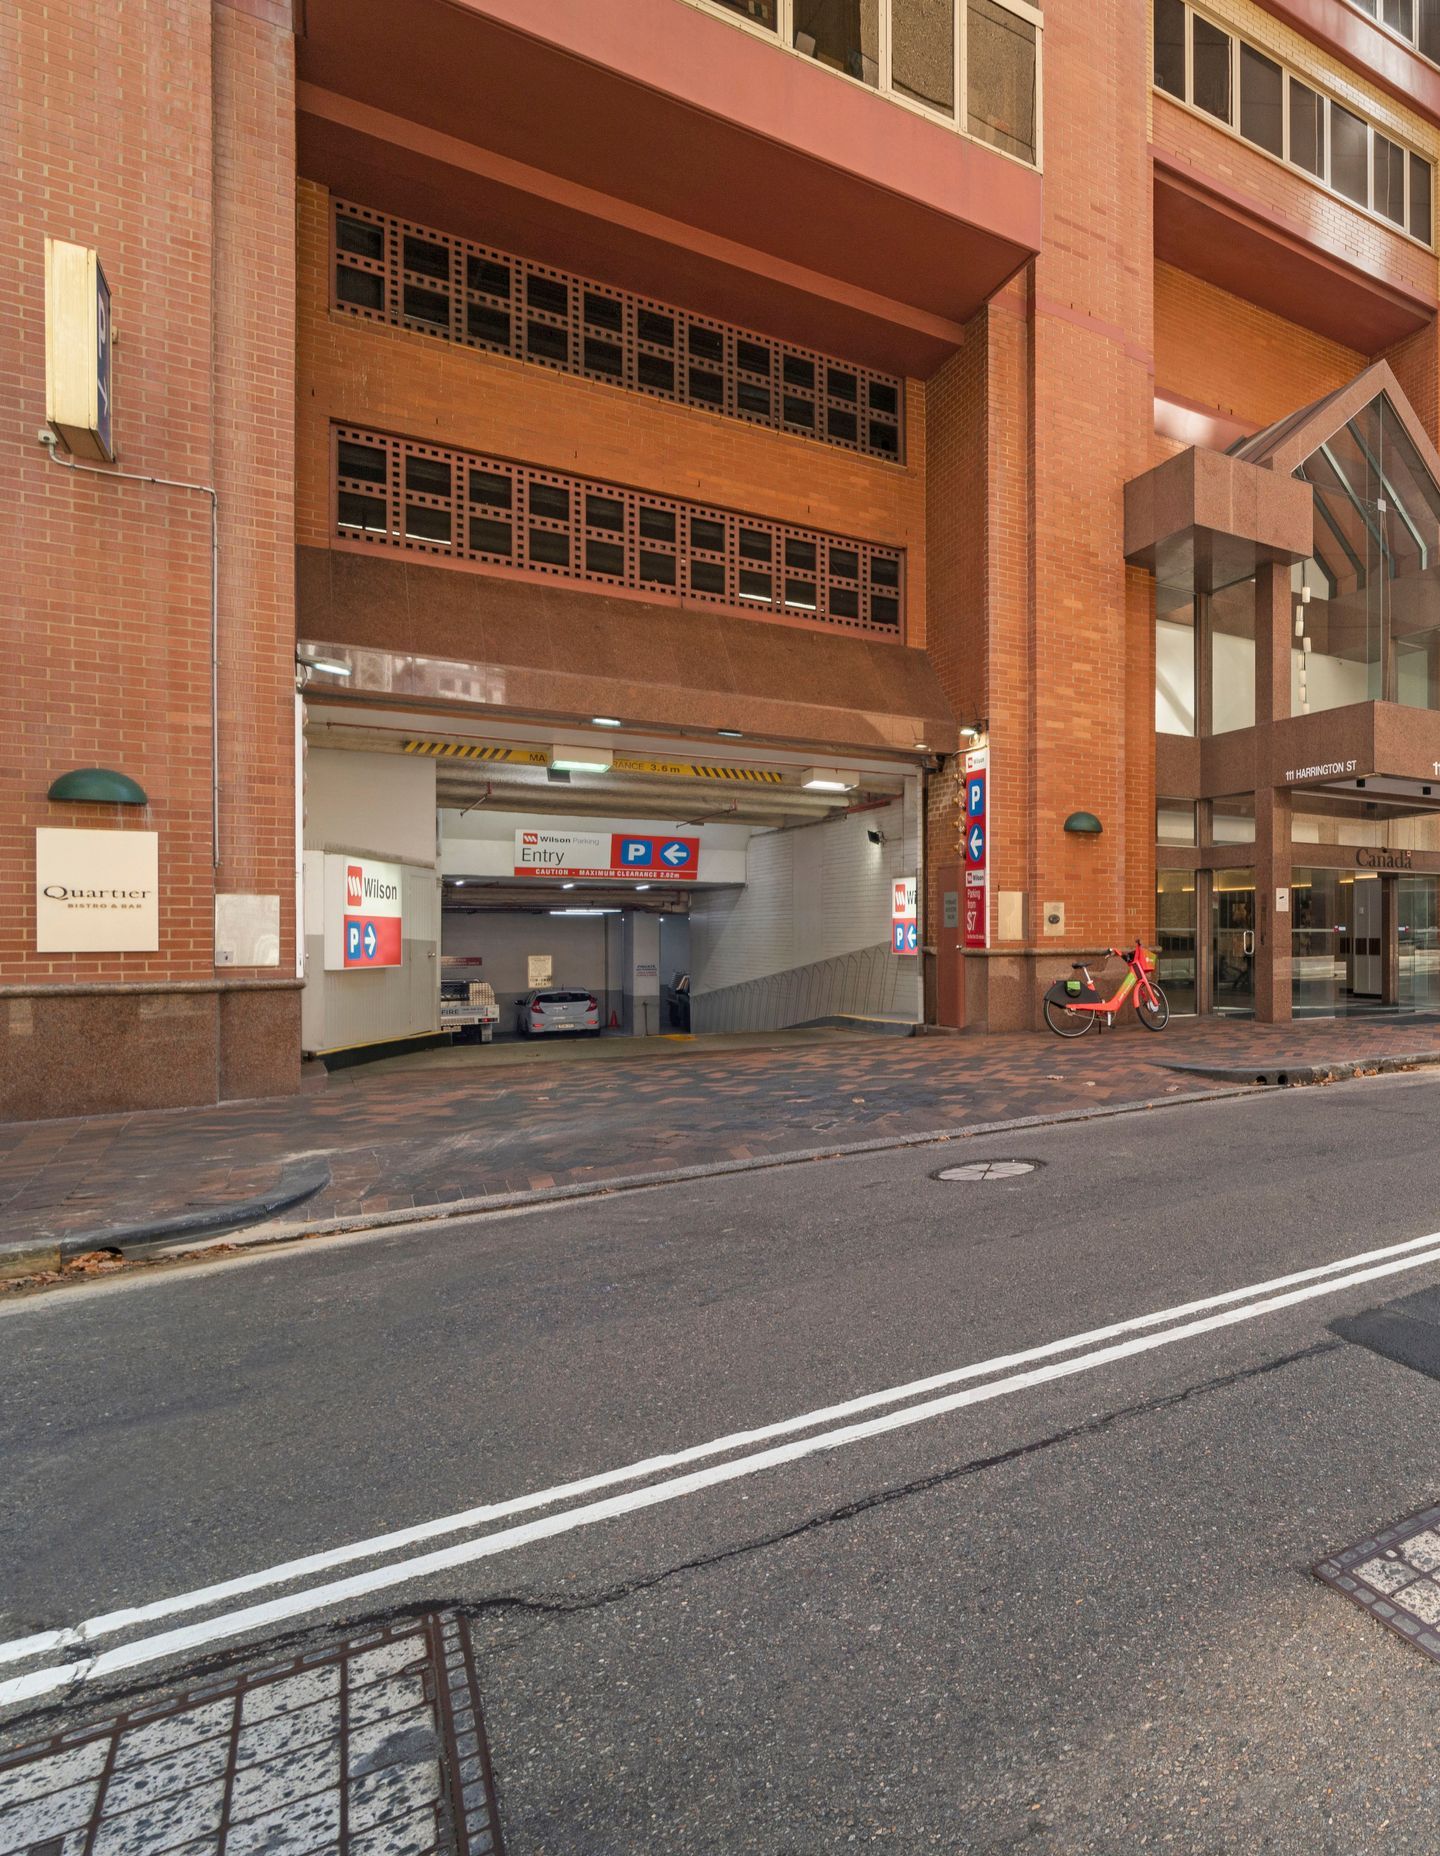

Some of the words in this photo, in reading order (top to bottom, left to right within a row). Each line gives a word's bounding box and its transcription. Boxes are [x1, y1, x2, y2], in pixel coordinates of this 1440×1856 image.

[529, 754, 547, 762] MA
[613, 760, 646, 770] RANCE
[1286, 770, 1294, 780] 111
[1296, 762, 1344, 779] HARRINGTON
[1346, 760, 1357, 772] ST
[971, 785, 981, 810] P
[540, 836, 571, 844] Wilson
[572, 837, 600, 846] Parking
[522, 847, 565, 865] Entry
[628, 844, 646, 861] P
[1355, 847, 1412, 869] Canada
[43, 885, 151, 900] Quartier
[364, 877, 397, 900] Wilson
[967, 889, 981, 900] Parking
[966, 910, 977, 934] $7
[350, 927, 359, 953] P
[896, 928, 904, 946] P
